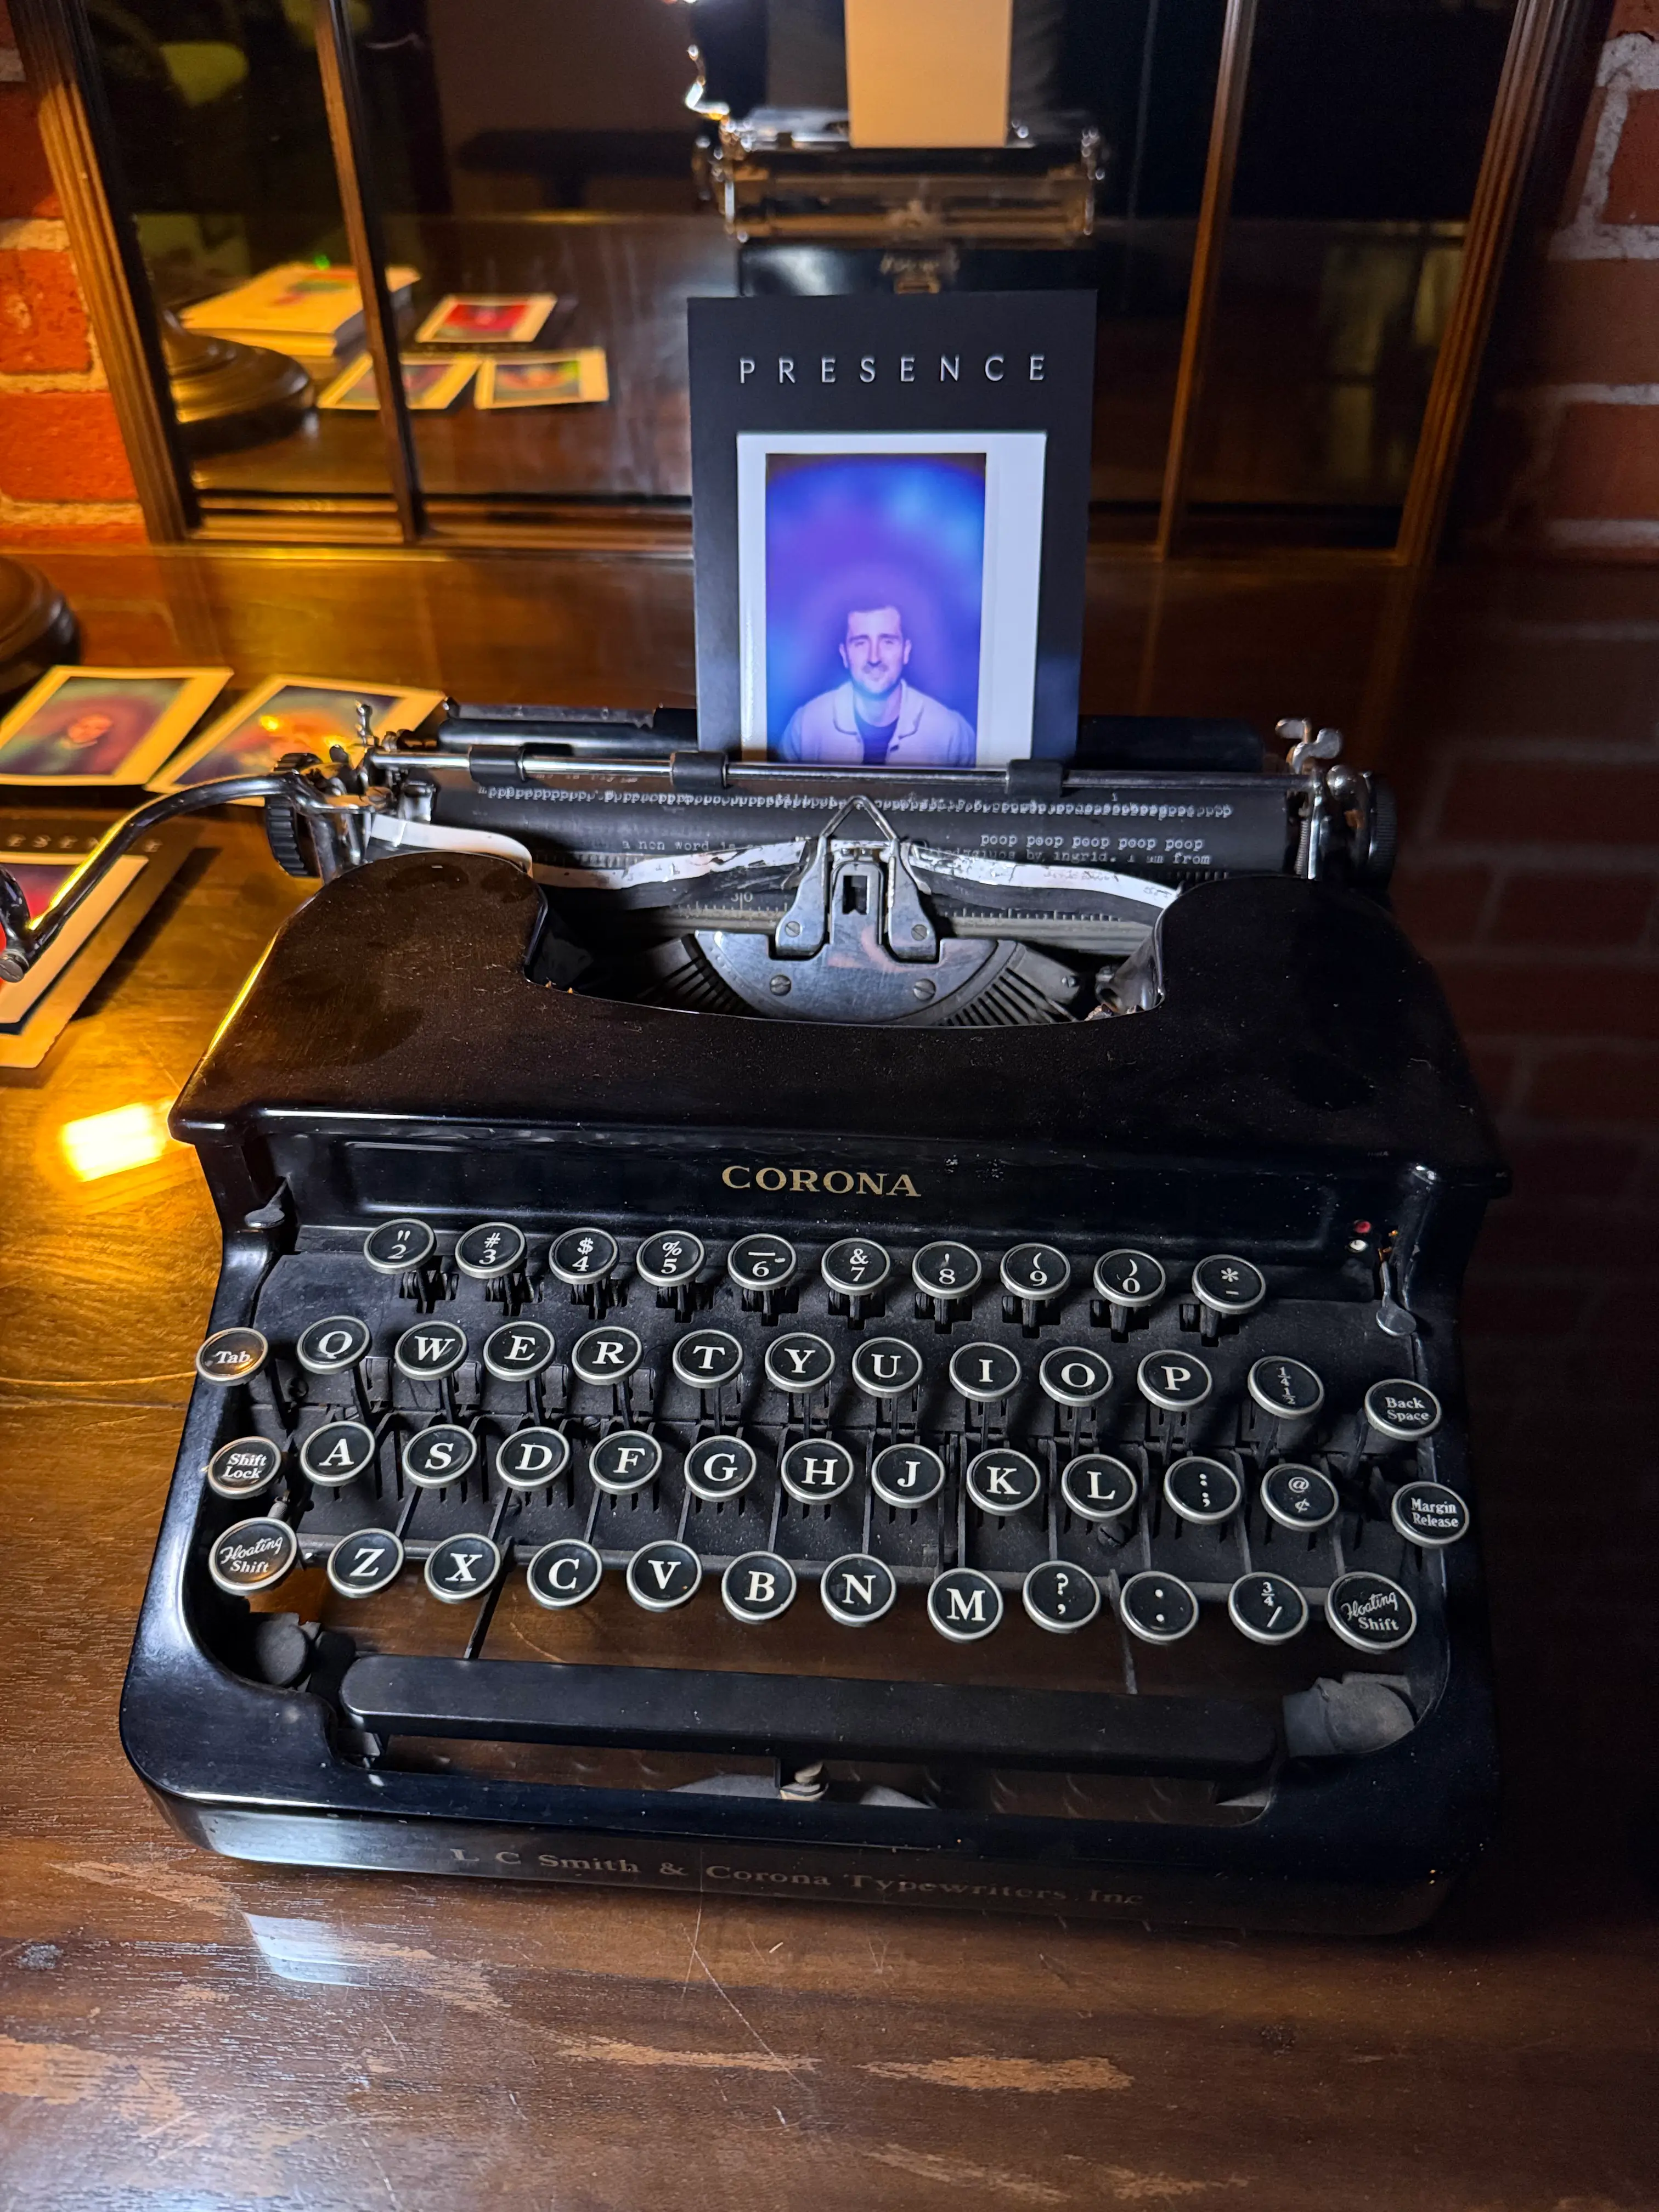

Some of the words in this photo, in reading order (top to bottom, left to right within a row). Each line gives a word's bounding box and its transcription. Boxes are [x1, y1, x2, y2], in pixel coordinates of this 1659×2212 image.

[740, 356, 1044, 383] PRESENCE
[675, 840, 709, 850] word
[980, 834, 1017, 847] poop
[1026, 836, 1063, 848] poop
[1072, 836, 1109, 849] poop
[1118, 837, 1156, 850] poop
[1165, 839, 1204, 851] poop
[1173, 852, 1210, 865] from
[722, 1165, 922, 1197] CORONA
[387, 1244, 407, 1259] 2
[479, 1249, 496, 1265] 3
[572, 1256, 589, 1272] 4
[661, 1258, 678, 1274] 5
[752, 1261, 770, 1277] 6
[850, 1266, 865, 1282] 7
[939, 1268, 956, 1285] 8
[1030, 1270, 1047, 1286] 9
[1122, 1277, 1141, 1293] 0
[318, 1330, 353, 1359] Q
[414, 1335, 455, 1362] W
[504, 1335, 535, 1361] E
[592, 1341, 625, 1364] R
[692, 1345, 726, 1369] T
[212, 1351, 251, 1364] Tab
[784, 1348, 816, 1374] Y
[871, 1353, 901, 1378] U
[979, 1359, 994, 1383] I
[1061, 1363, 1096, 1388] O
[1161, 1365, 1191, 1391] P
[1385, 1397, 1425, 1409] Back
[1387, 1409, 1429, 1422] Space
[227, 1453, 267, 1466] Shift
[319, 1438, 354, 1466] A
[425, 1442, 454, 1470] S
[515, 1443, 552, 1471] D
[613, 1447, 646, 1474] F
[222, 1466, 262, 1479] Lock
[703, 1453, 738, 1482] G
[801, 1457, 838, 1485] H
[897, 1460, 921, 1487] J
[986, 1466, 1021, 1495] K
[1087, 1471, 1115, 1500] L
[1411, 1498, 1457, 1514] Margin
[1412, 1512, 1459, 1527] Release
[219, 1537, 283, 1565] Floating
[349, 1548, 385, 1577] Z
[230, 1560, 269, 1573] Shift
[445, 1553, 483, 1582] X
[548, 1558, 580, 1589] C
[647, 1560, 681, 1589] V
[744, 1570, 775, 1602] B
[842, 1573, 877, 1605] N
[946, 1588, 986, 1621] M
[1341, 1592, 1398, 1622] Floating
[1358, 1617, 1399, 1630] Shift
[450, 1848, 478, 1862] L
[495, 1852, 522, 1864] C
[538, 1854, 641, 1873] Smith
[660, 1863, 687, 1876] &
[706, 1865, 831, 1885] Corona
[843, 1874, 1066, 1901] Typewriters
[1088, 1889, 1143, 1904] Inc
